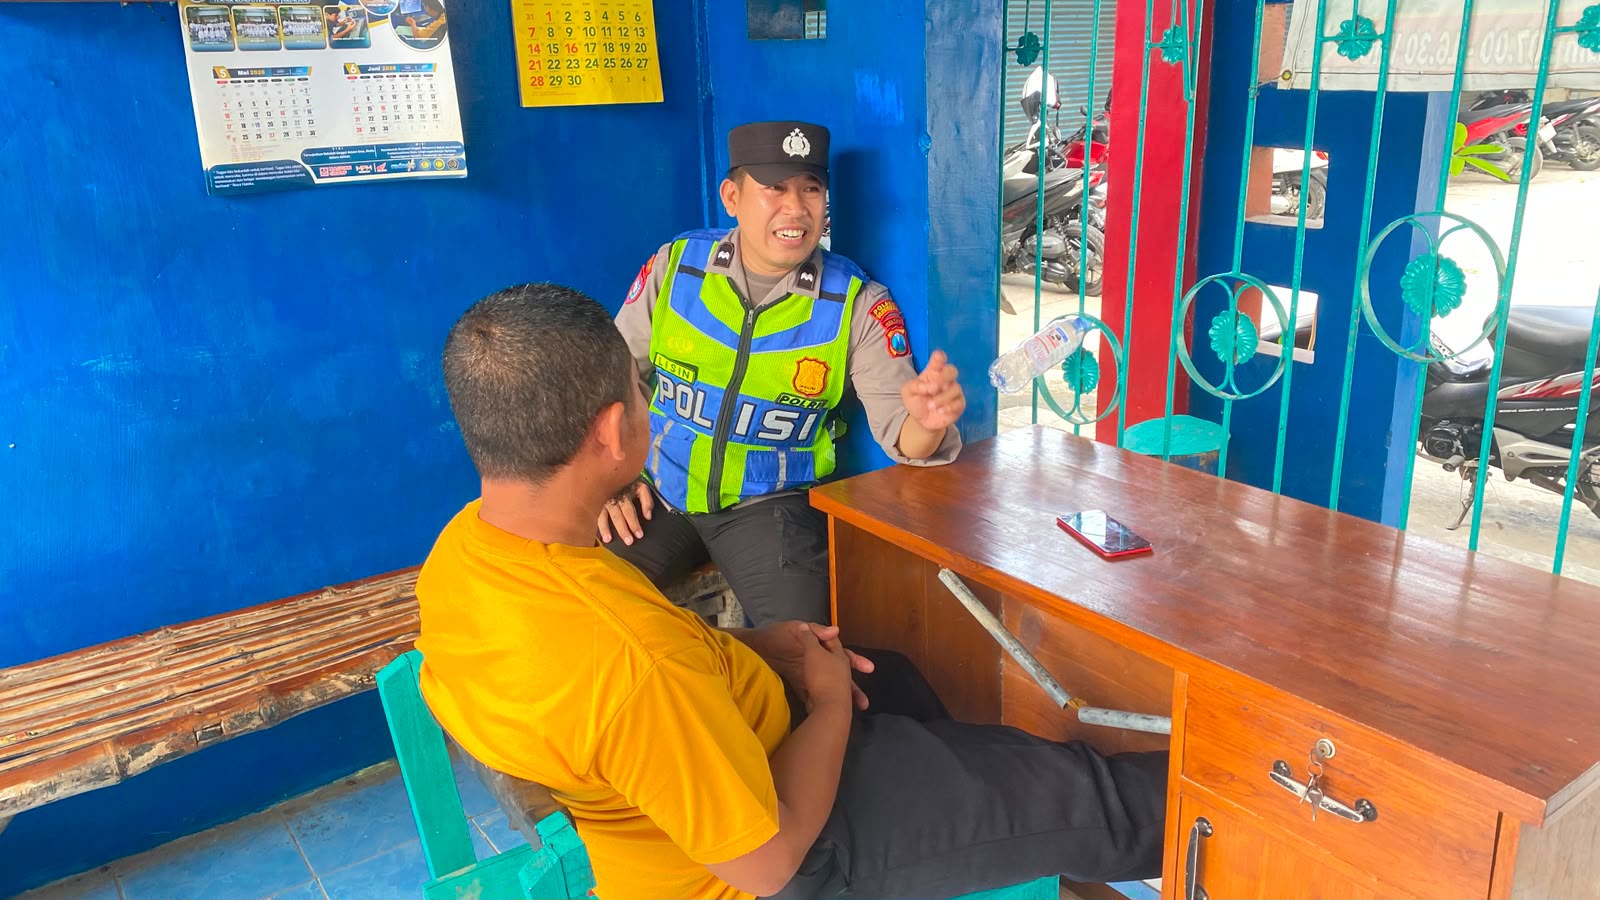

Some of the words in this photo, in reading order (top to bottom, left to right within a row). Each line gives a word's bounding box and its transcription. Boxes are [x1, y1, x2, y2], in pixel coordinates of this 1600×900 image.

[546, 11, 552, 21] 1
[565, 12, 572, 21] 2
[584, 11, 591, 21] 3
[602, 11, 608, 20] 4
[619, 11, 624, 20] 5
[635, 12, 641, 21] 6
[528, 28, 535, 37] 7
[548, 27, 554, 37] 8
[566, 27, 572, 37] 9
[583, 27, 596, 36] 10
[601, 27, 612, 36] 11
[618, 27, 629, 37] 12
[634, 28, 645, 37] 13
[528, 44, 540, 54] 14
[547, 44, 559, 53] 15
[565, 43, 578, 53] 16
[584, 43, 596, 52] 17
[603, 43, 614, 52] 18
[619, 43, 630, 52] 19
[635, 43, 647, 52] 20
[350, 64, 355, 73] 6
[529, 60, 542, 70] 21
[548, 60, 560, 69] 22
[566, 59, 580, 69] 23
[585, 58, 599, 68] 24
[604, 58, 616, 68] 25
[620, 58, 632, 68] 26
[637, 58, 648, 68] 27
[220, 69, 226, 78] 5
[530, 76, 544, 86] 28
[550, 76, 562, 85] 29
[568, 75, 582, 85] 30
[656, 355, 690, 380] LISIN
[779, 395, 821, 409] POLRI
